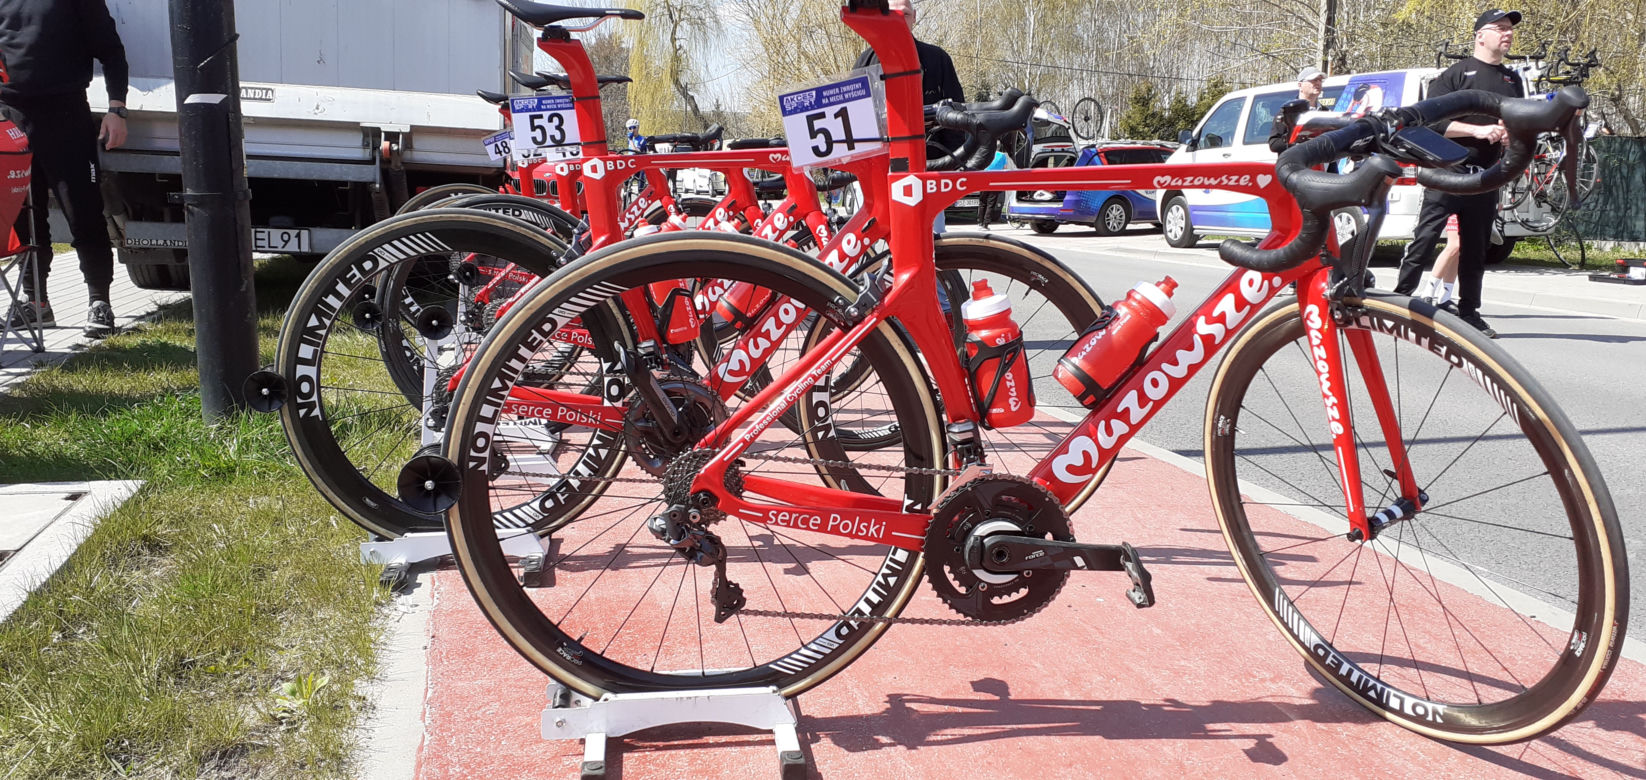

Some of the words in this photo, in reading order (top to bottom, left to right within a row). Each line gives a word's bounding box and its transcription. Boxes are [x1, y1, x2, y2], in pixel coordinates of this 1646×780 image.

[783, 90, 816, 105] AKCES
[785, 99, 816, 111] SPORT
[528, 112, 566, 146] 53
[805, 106, 856, 158] 51
[494, 140, 511, 157] 48
[606, 158, 636, 171] BDC
[926, 177, 967, 193] BDC
[126, 237, 188, 248] DHOLLANDI
[298, 252, 380, 363] LIMITED
[479, 317, 560, 425] LIMITED
[743, 401, 788, 442] Professional
[786, 376, 815, 403] Cycling
[812, 359, 833, 377] Team
[511, 403, 552, 418] serce
[556, 406, 603, 425] Polski
[769, 510, 821, 530] serce
[827, 514, 886, 539] Polski
